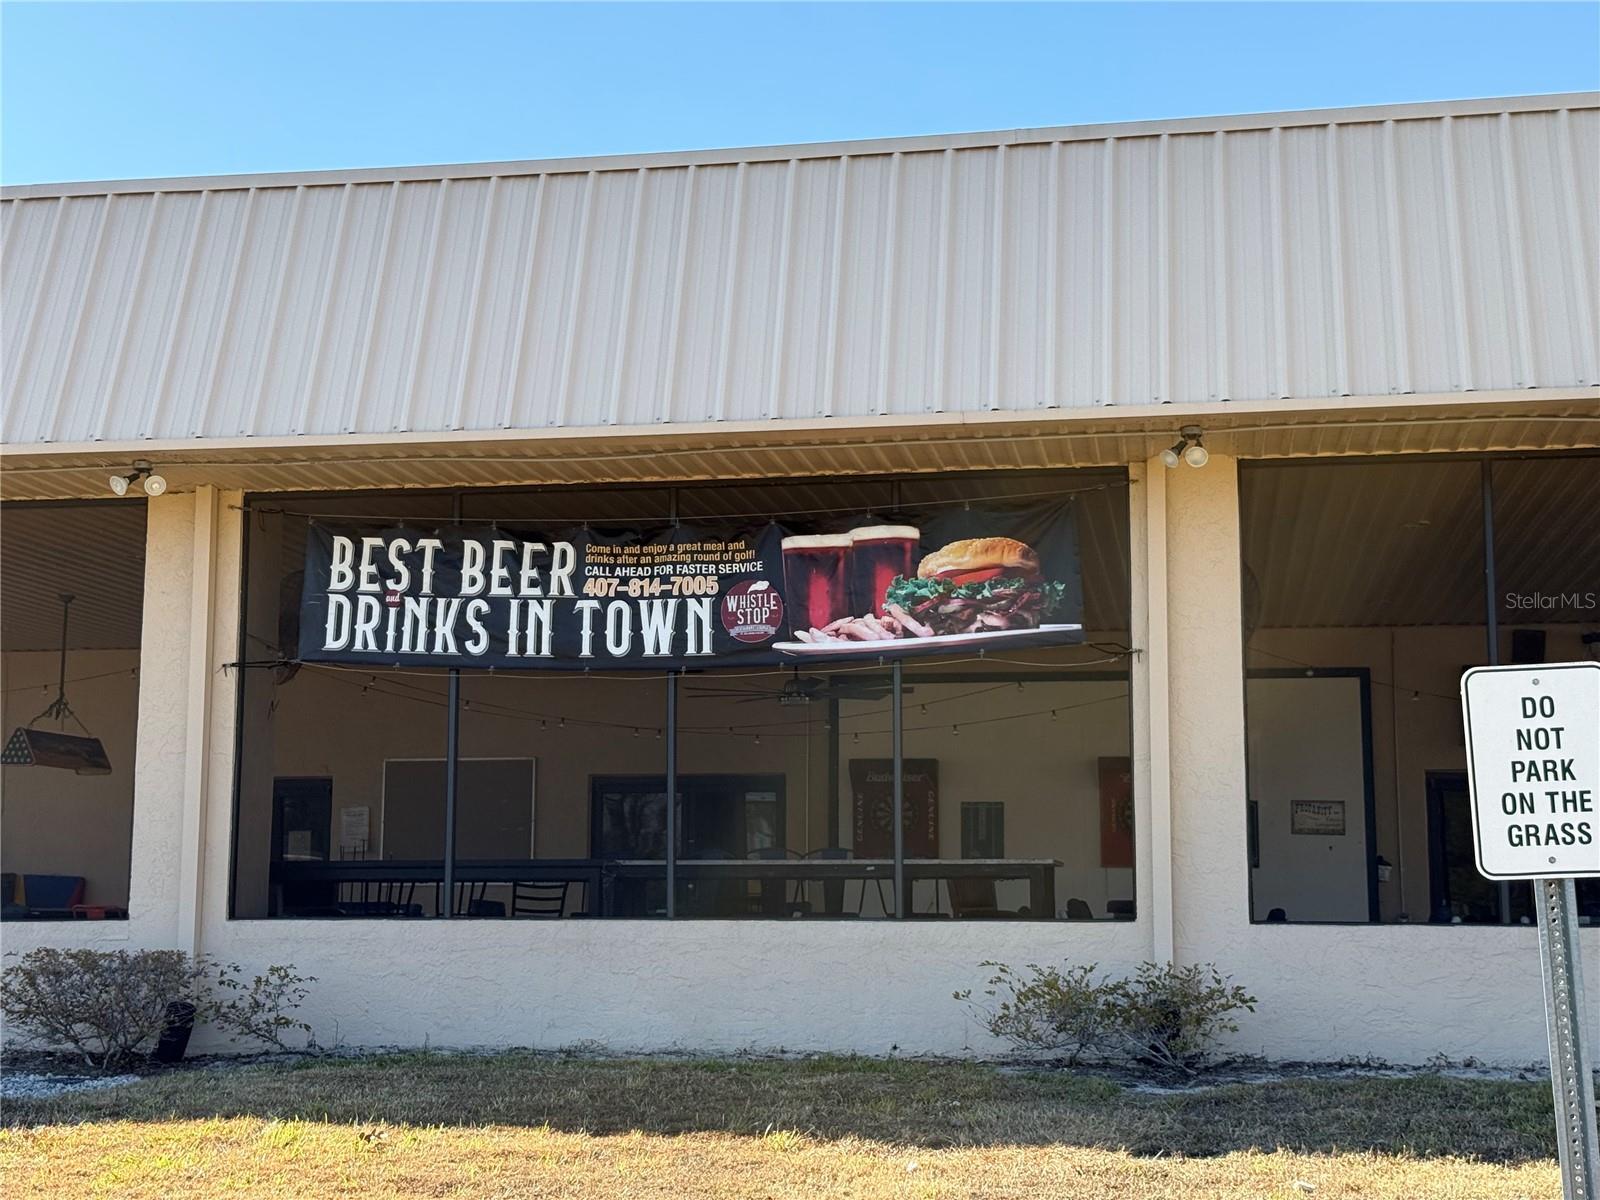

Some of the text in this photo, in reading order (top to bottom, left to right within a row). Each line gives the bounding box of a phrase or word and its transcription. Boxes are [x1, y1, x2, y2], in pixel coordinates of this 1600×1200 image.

[585, 540, 745, 555] Come in and enjoy a great meal and
[585, 549, 756, 564] drinks after an amazing round of golf!
[326, 536, 579, 597] BEST BEER
[584, 561, 764, 577] CALL AHEAD FOR FASTER SERVICE
[583, 575, 719, 597] 407-814-7005
[385, 593, 401, 604] and
[726, 592, 778, 612] WHISTLE
[737, 607, 770, 625] STOP
[505, 599, 556, 657] IN
[572, 597, 717, 658] TOWN
[1521, 696, 1555, 719] DO
[1516, 727, 1564, 750] NOT
[1511, 759, 1576, 782] PARK
[1501, 790, 1593, 815] ON THE
[1507, 822, 1592, 847] GRASS
